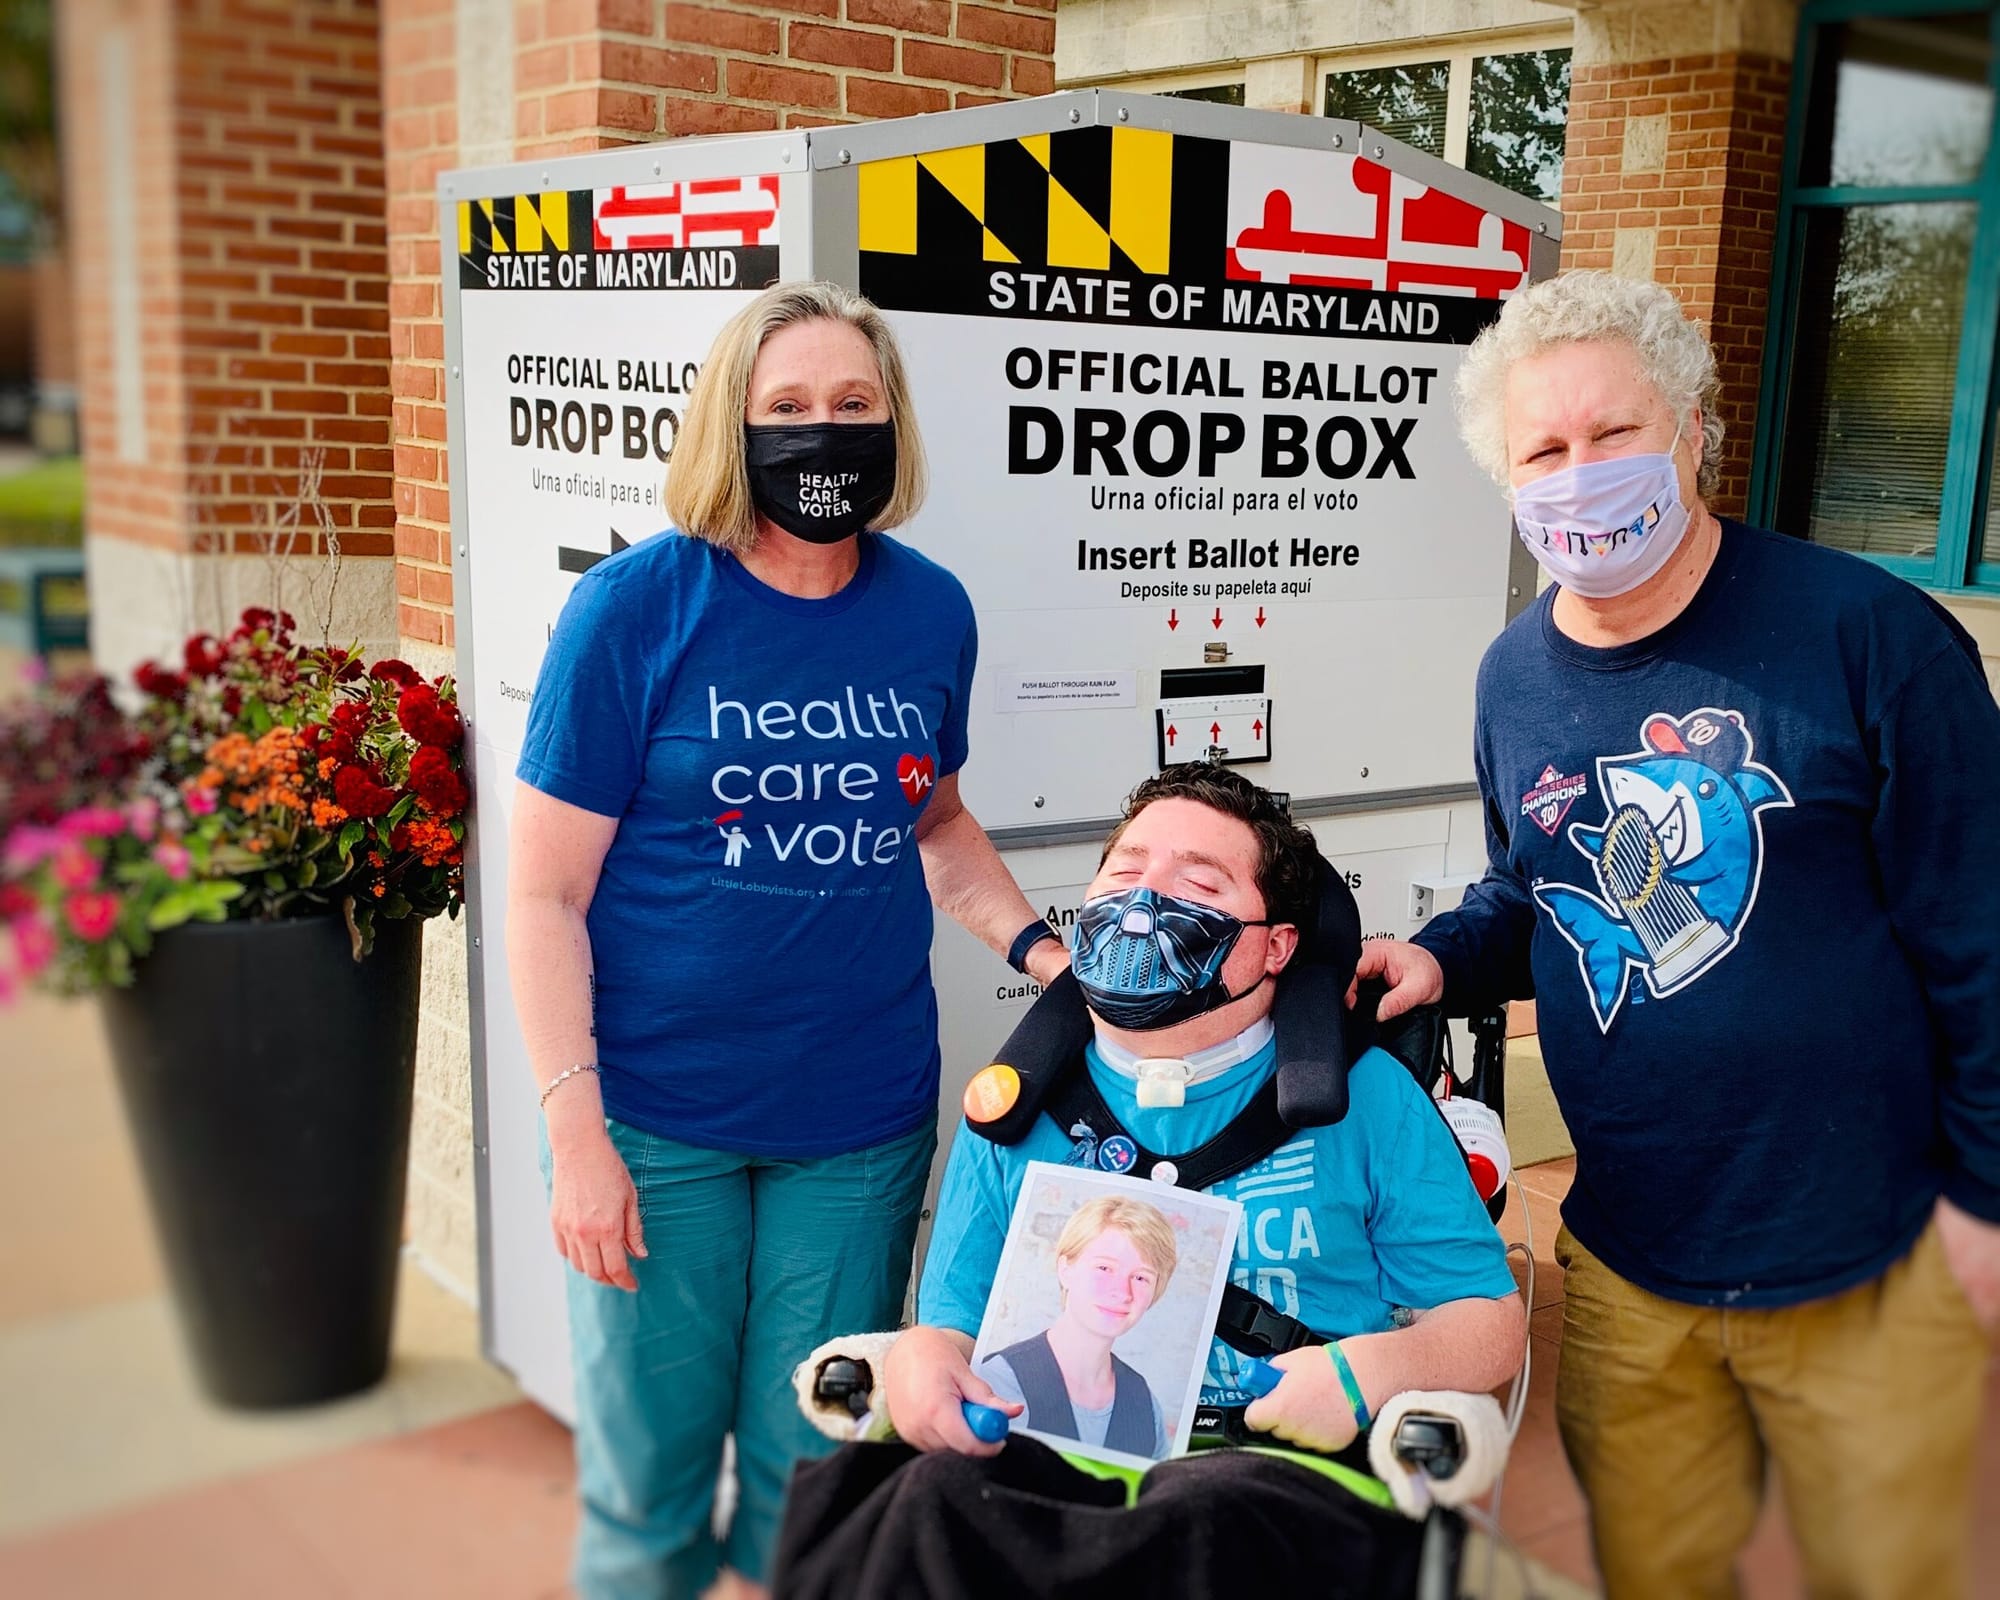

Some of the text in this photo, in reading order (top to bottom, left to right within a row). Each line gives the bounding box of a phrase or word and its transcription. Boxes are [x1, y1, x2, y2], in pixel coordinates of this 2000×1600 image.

[486, 250, 737, 288] STATE OF MARYLAND
[988, 271, 1440, 336] STATE OF MARYLAND
[507, 354, 704, 394] OFFICIAL BALLO
[1005, 346, 1438, 404] OFFICIAL BALLOT
[510, 396, 682, 464] DROP BO
[1007, 404, 1420, 480] DROP BOX
[532, 467, 657, 506] Urna oficial para el
[799, 472, 859, 489] HEALTH
[799, 486, 841, 503] CARE
[799, 499, 852, 518] VOTER
[1091, 485, 1359, 516] Urna oficial para el voto
[1077, 537, 1361, 571] Insert Ballot Here
[1121, 577, 1312, 601] Deposite su papeleta aquí
[708, 685, 928, 740] health
[711, 762, 879, 805] care
[1521, 782, 1588, 816] CHAMPIONS
[711, 876, 816, 899] LittleLobbyists.org
[1195, 1417, 1218, 1427] JAY
